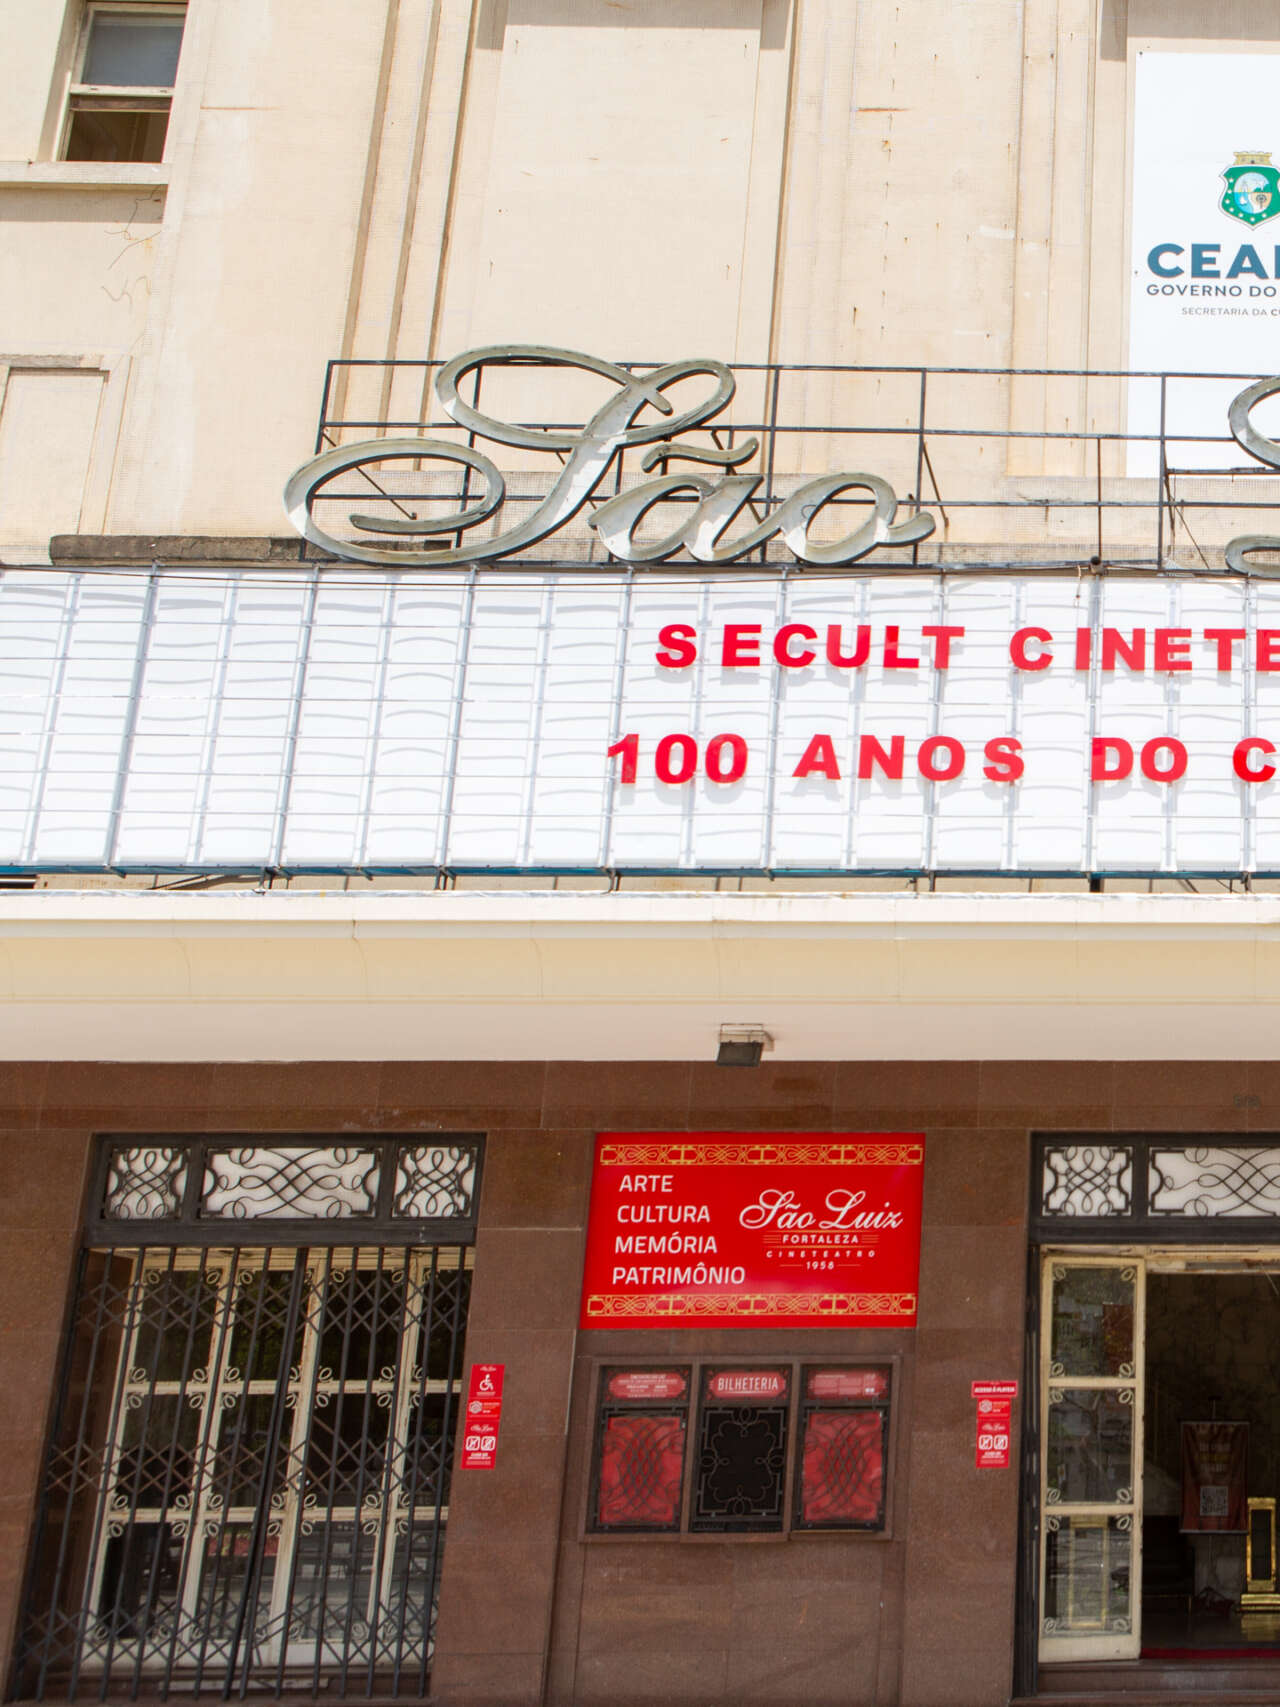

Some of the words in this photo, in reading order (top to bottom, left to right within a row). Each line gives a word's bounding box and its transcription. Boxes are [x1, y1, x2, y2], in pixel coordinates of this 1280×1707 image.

[1147, 284, 1242, 298] GOVERNO
[1249, 286, 1277, 298] DO
[1182, 306, 1249, 317] SECRETARIA
[1252, 308, 1268, 317] DA
[283, 343, 936, 567] São
[655, 622, 966, 669] SECULT
[607, 733, 748, 784] 100
[792, 734, 1025, 783] ANOS
[1091, 736, 1189, 782] DO
[619, 1174, 674, 1193] ARTE
[617, 1205, 711, 1224] CULTURA
[739, 1188, 816, 1230] São
[818, 1188, 904, 1230] Luiz
[614, 1231, 718, 1254] MEMÓRIA
[782, 1234, 859, 1244] FORTALEZA
[766, 1250, 875, 1258] CINETEATRO
[612, 1262, 746, 1286] PATRIMÔNIO
[806, 1260, 834, 1270] 1958
[717, 1376, 779, 1392] BILHETERIA
